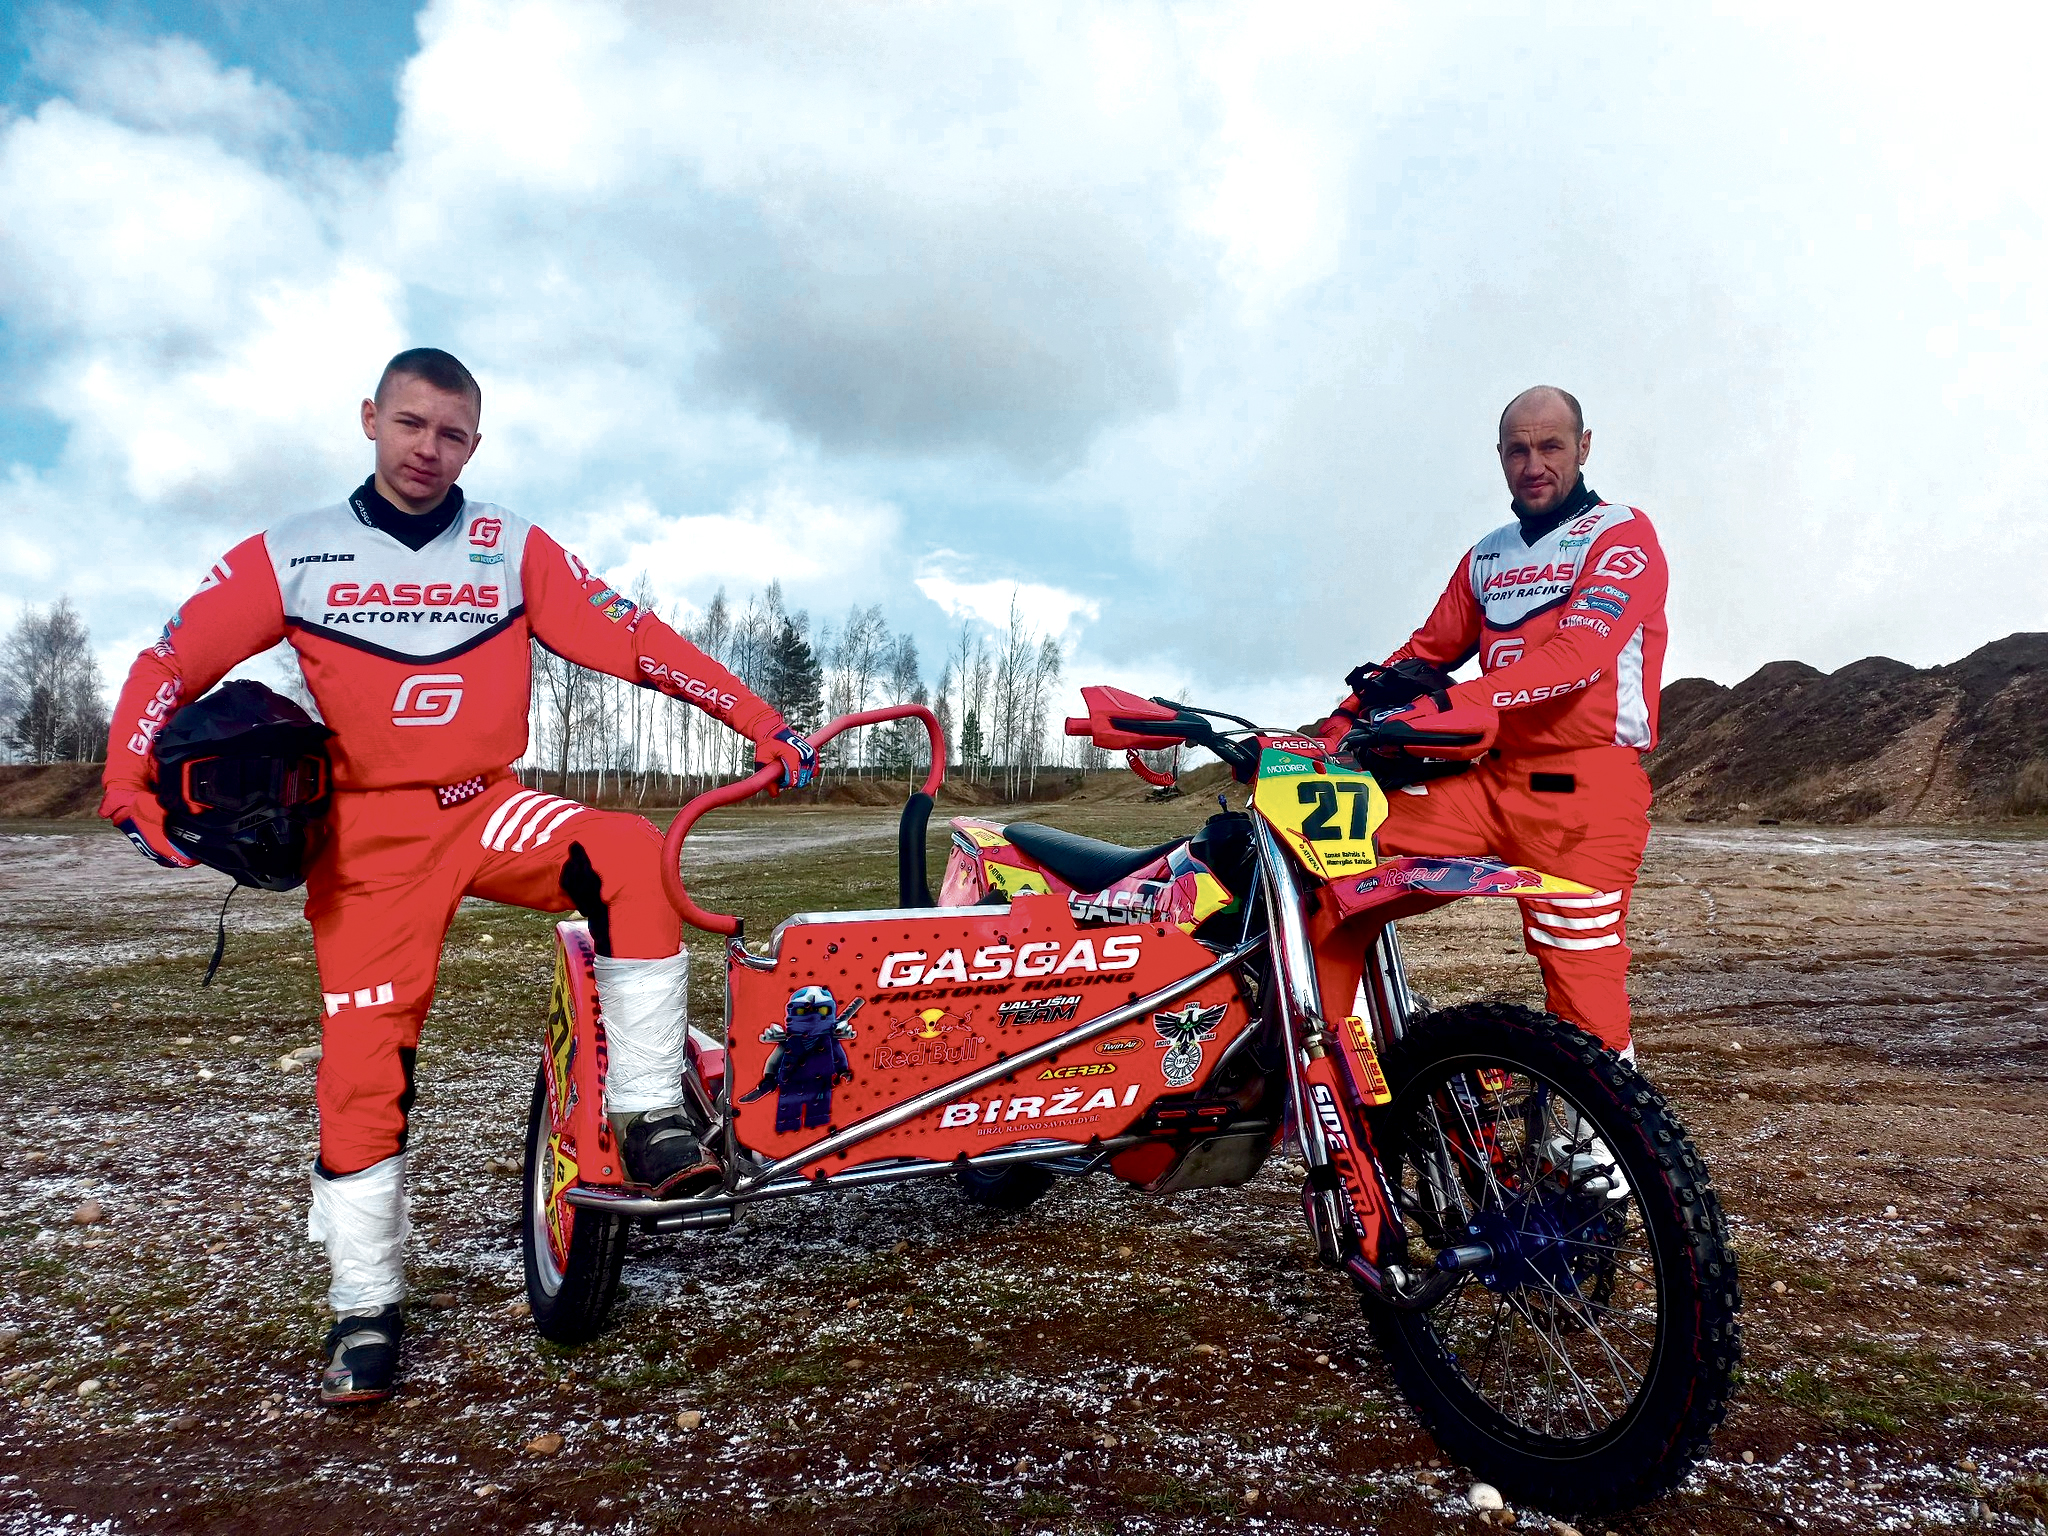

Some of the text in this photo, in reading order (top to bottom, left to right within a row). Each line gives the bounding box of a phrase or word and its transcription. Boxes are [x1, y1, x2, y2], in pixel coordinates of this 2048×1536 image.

[354, 499, 372, 527] GASGA
[326, 583, 499, 607] GASGAS
[1485, 585, 1572, 603] TORY RACING
[322, 611, 499, 625] FACTORY RACING
[639, 655, 739, 711] GASGAS
[1492, 668, 1602, 708] GASGAS
[1271, 741, 1326, 750] GASGAS
[1267, 764, 1309, 774] MOTOREX
[1297, 781, 1369, 841] 27
[1067, 888, 1154, 925] GASGA
[876, 935, 1143, 988] GASGAS
[871, 972, 1135, 1004] FACTORY RACING
[996, 1004, 1079, 1028] TEAM
[873, 1036, 978, 1069] Red Bull
[1102, 1040, 1138, 1051] Twin Air
[938, 1084, 1142, 1129] BIRŽAI
[1006, 1121, 1042, 1133] RAJONO
[1339, 1176, 1365, 1237] SERVICE
